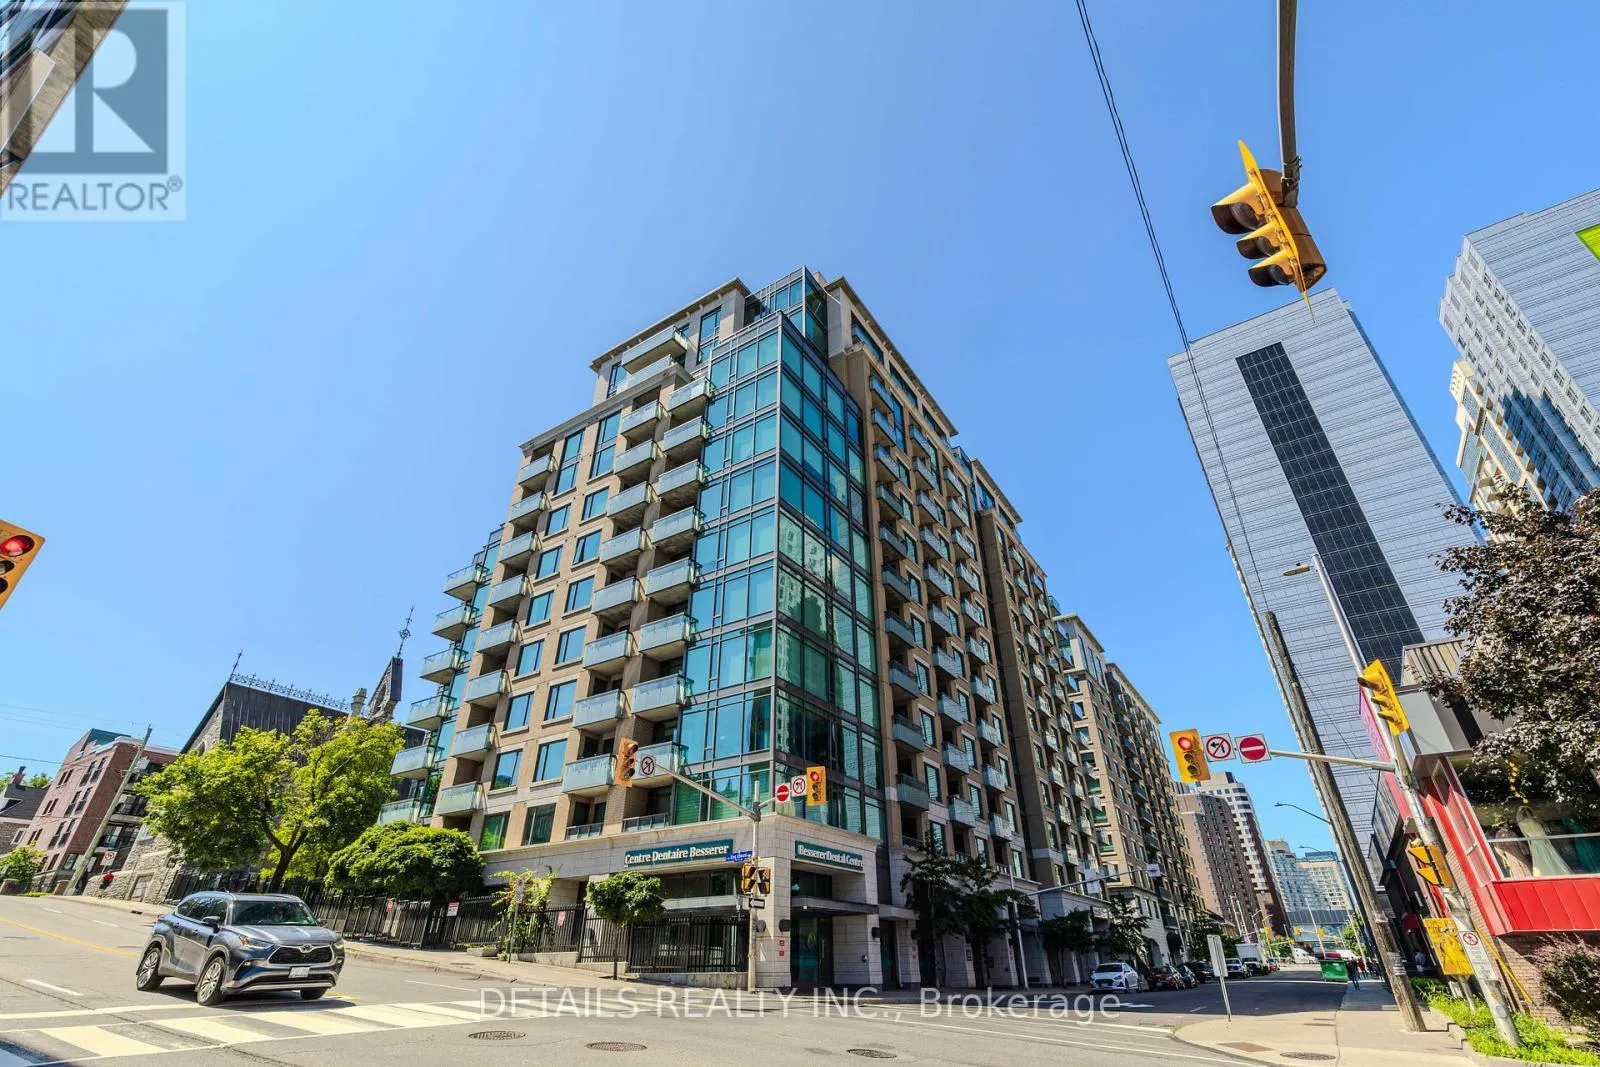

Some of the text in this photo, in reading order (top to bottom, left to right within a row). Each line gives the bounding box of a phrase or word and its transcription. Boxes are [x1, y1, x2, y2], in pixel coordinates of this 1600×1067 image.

[624, 854, 651, 865] Centre
[652, 848, 688, 861] Dentaire
[689, 845, 730, 858] Besserer
[798, 844, 864, 867] Besserer Dental Centre
